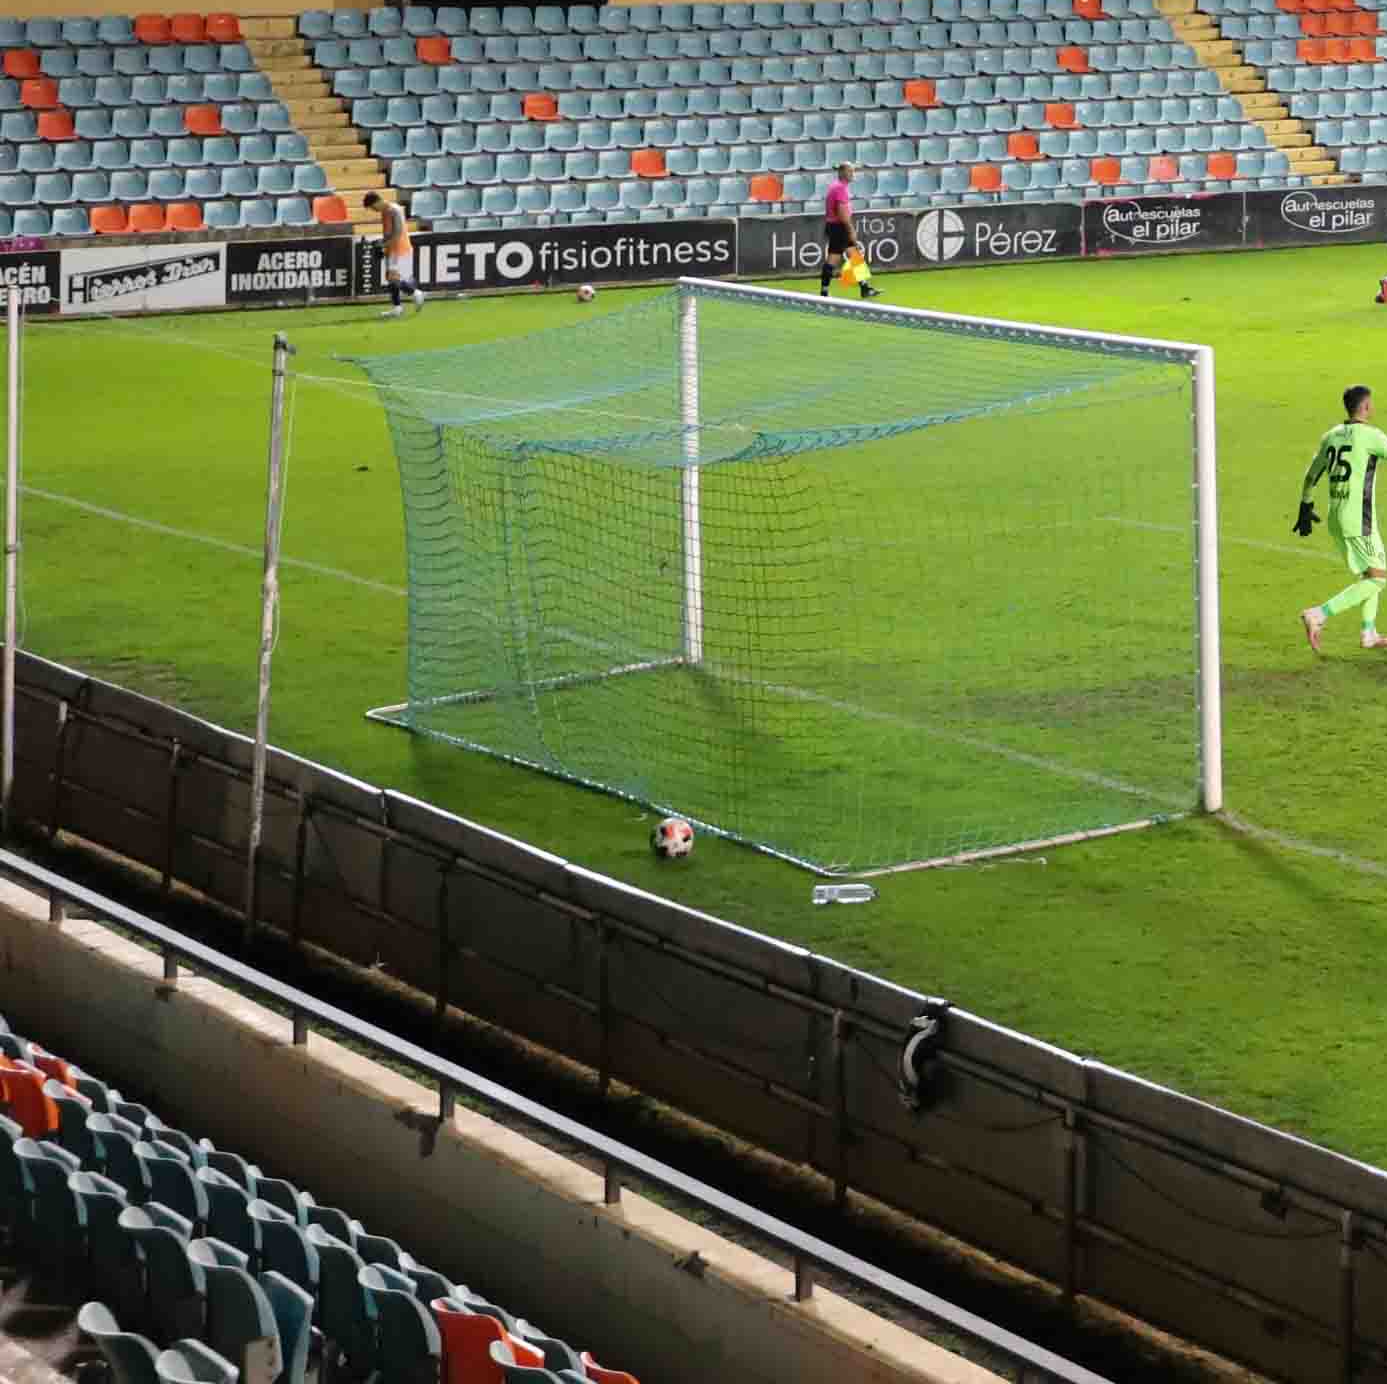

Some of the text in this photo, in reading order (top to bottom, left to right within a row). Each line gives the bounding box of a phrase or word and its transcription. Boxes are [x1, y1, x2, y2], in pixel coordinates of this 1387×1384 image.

[1133, 218, 1201, 240] el pilar
[1309, 210, 1374, 229] el pilar
[975, 222, 1057, 256] Pérez
[258, 250, 323, 270] ACERO
[380, 236, 731, 285] IETO fisiofitness
[231, 269, 349, 292] INOXIDABLE
